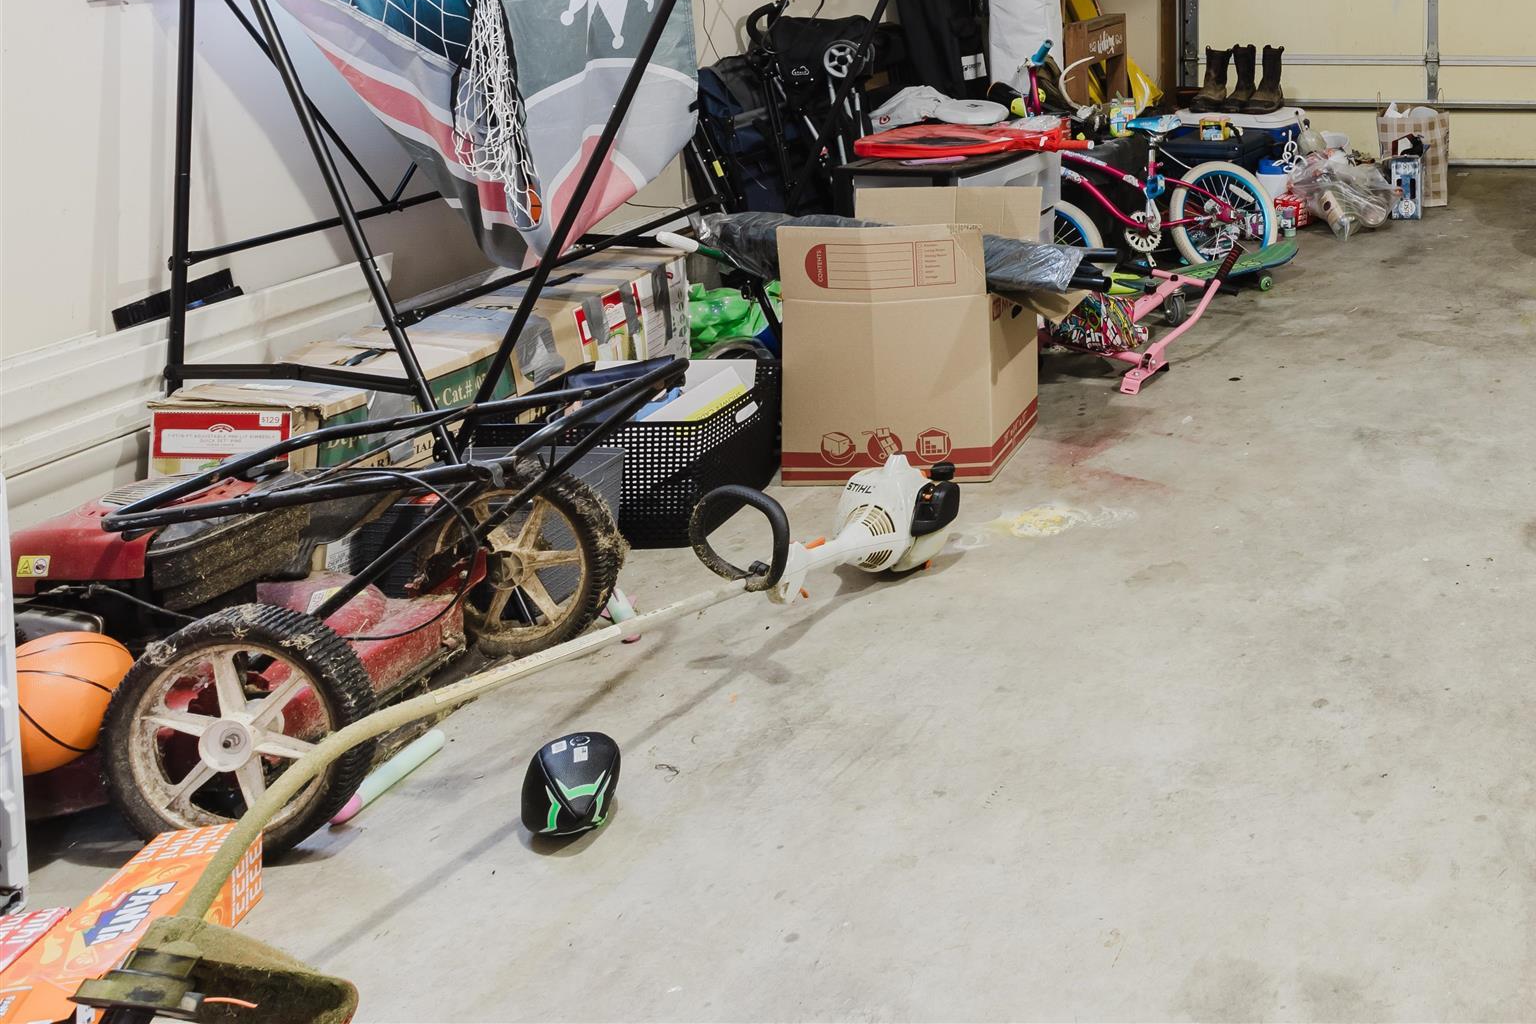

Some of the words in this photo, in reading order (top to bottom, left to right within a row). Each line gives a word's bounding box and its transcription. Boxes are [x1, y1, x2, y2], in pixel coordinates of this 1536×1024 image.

[261, 415, 280, 425] $129
[846, 481, 873, 494] STIHL
[89, 880, 178, 946] FANTA
